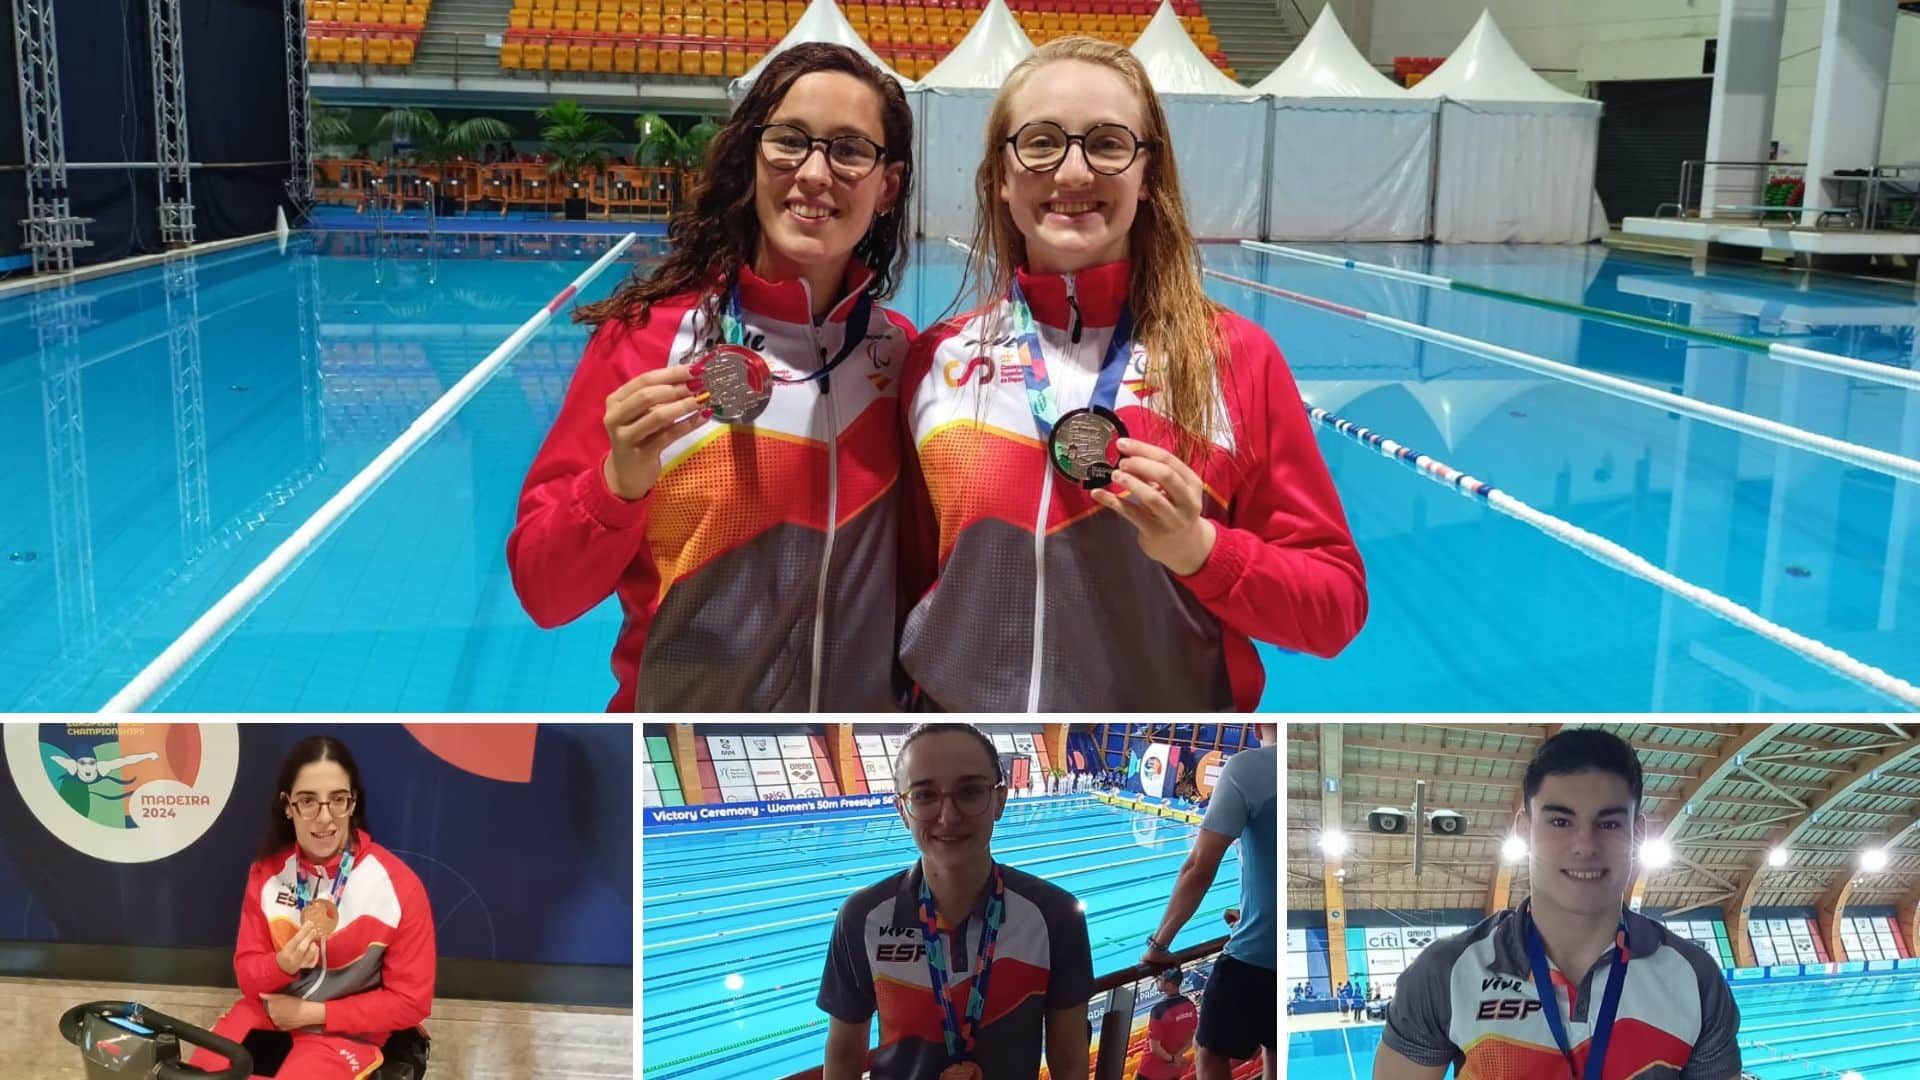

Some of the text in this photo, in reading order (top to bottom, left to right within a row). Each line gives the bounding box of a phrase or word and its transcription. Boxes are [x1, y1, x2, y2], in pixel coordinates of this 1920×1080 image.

[67, 727, 145, 736] CHAMPIONSHIPS
[141, 795, 210, 806] MADEIRA
[142, 807, 177, 818] 2024
[653, 810, 697, 822] Victory
[700, 806, 759, 819] Ceremony
[767, 800, 815, 813] Women's
[817, 799, 839, 810] 50m
[840, 796, 881, 808] Freestyle
[1407, 930, 1432, 938] arena
[1368, 932, 1398, 948] citi
[1476, 999, 1543, 1021] ESP
